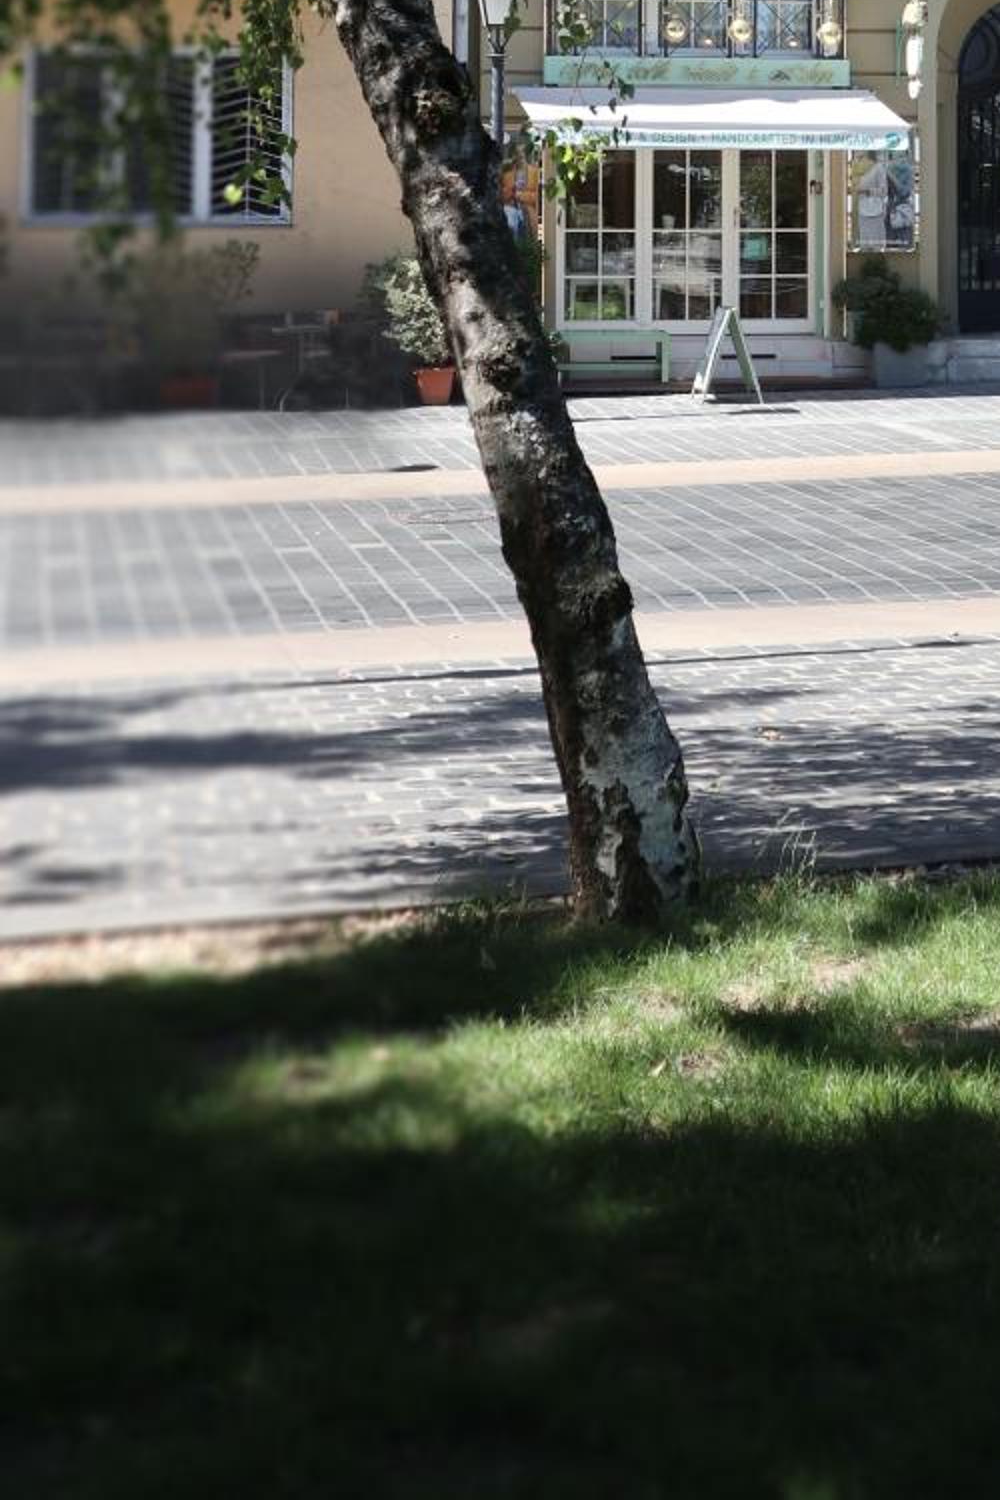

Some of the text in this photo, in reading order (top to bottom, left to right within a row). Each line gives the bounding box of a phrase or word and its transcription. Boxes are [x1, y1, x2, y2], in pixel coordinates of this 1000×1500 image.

[711, 132, 796, 145] HANDCRAFTED
[801, 133, 815, 145] IN
[819, 133, 875, 146] HUNGARY
